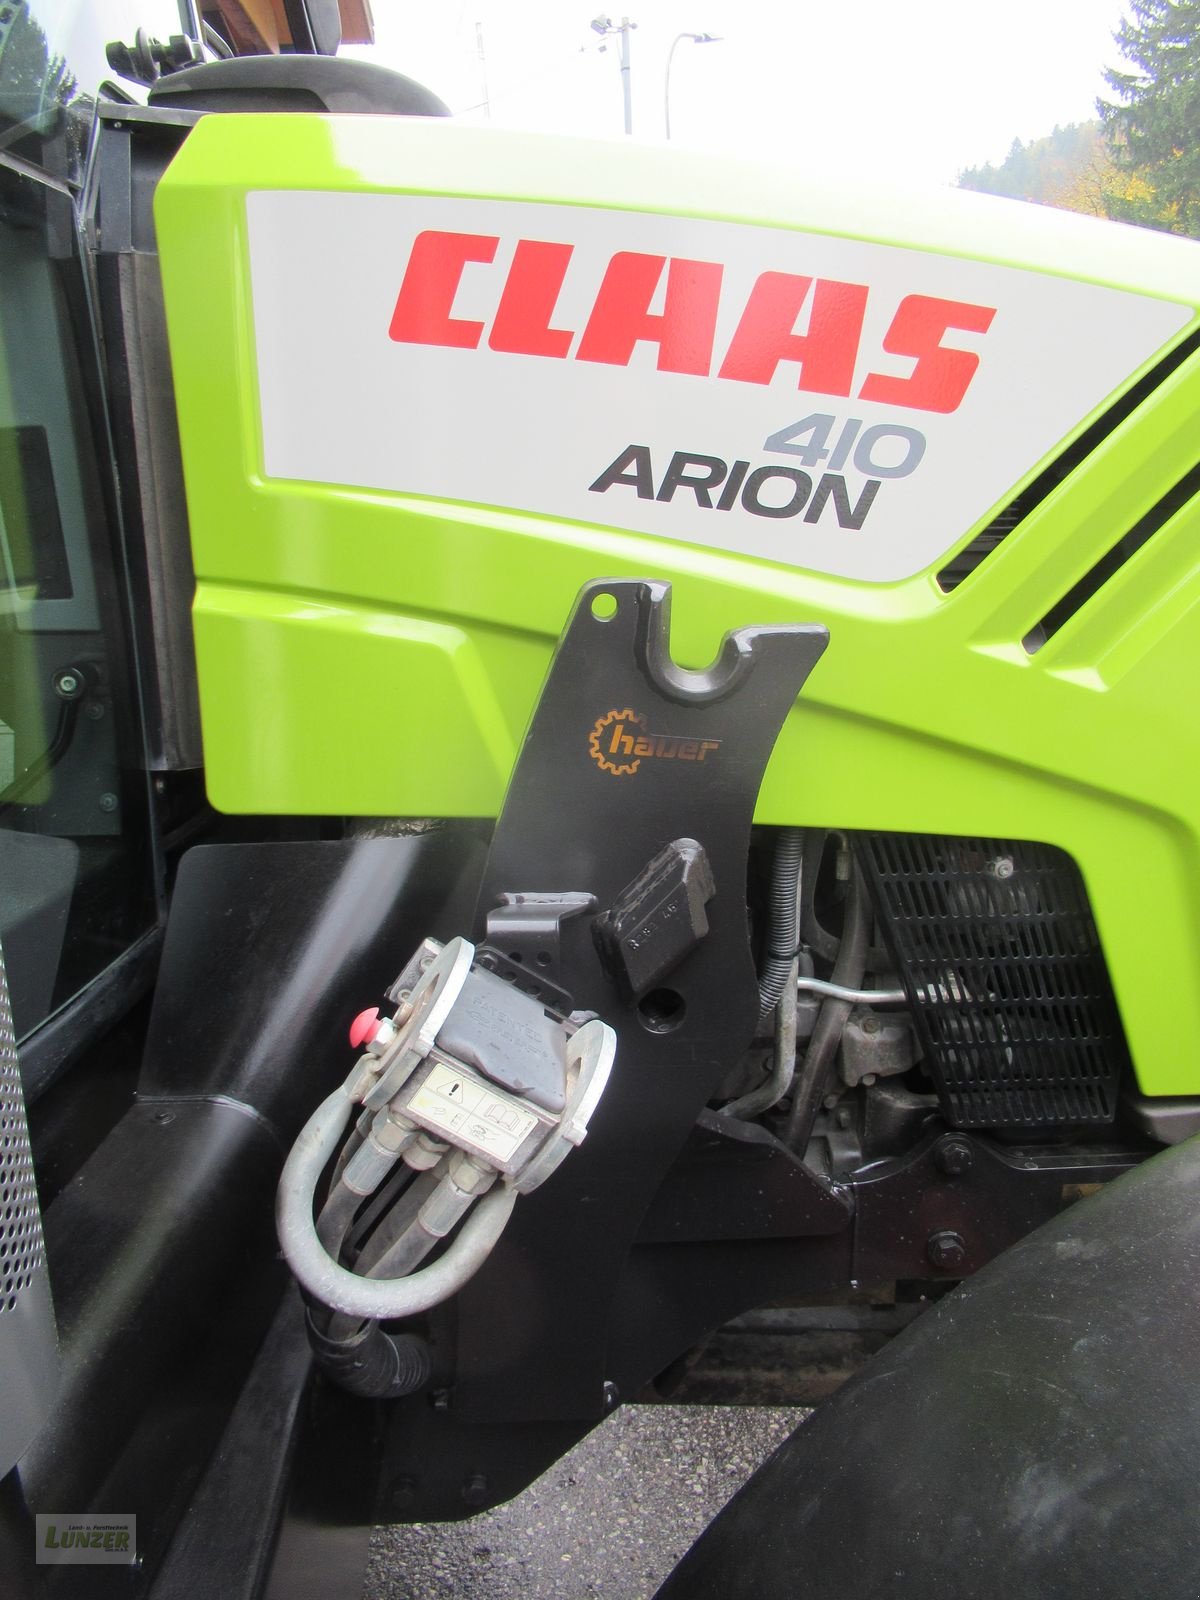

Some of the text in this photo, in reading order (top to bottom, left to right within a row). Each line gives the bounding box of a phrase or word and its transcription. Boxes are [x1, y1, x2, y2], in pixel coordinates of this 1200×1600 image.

[388, 230, 997, 414] CLAAS
[763, 413, 927, 479] 410
[588, 444, 881, 531] ARION
[609, 724, 720, 761] hauer
